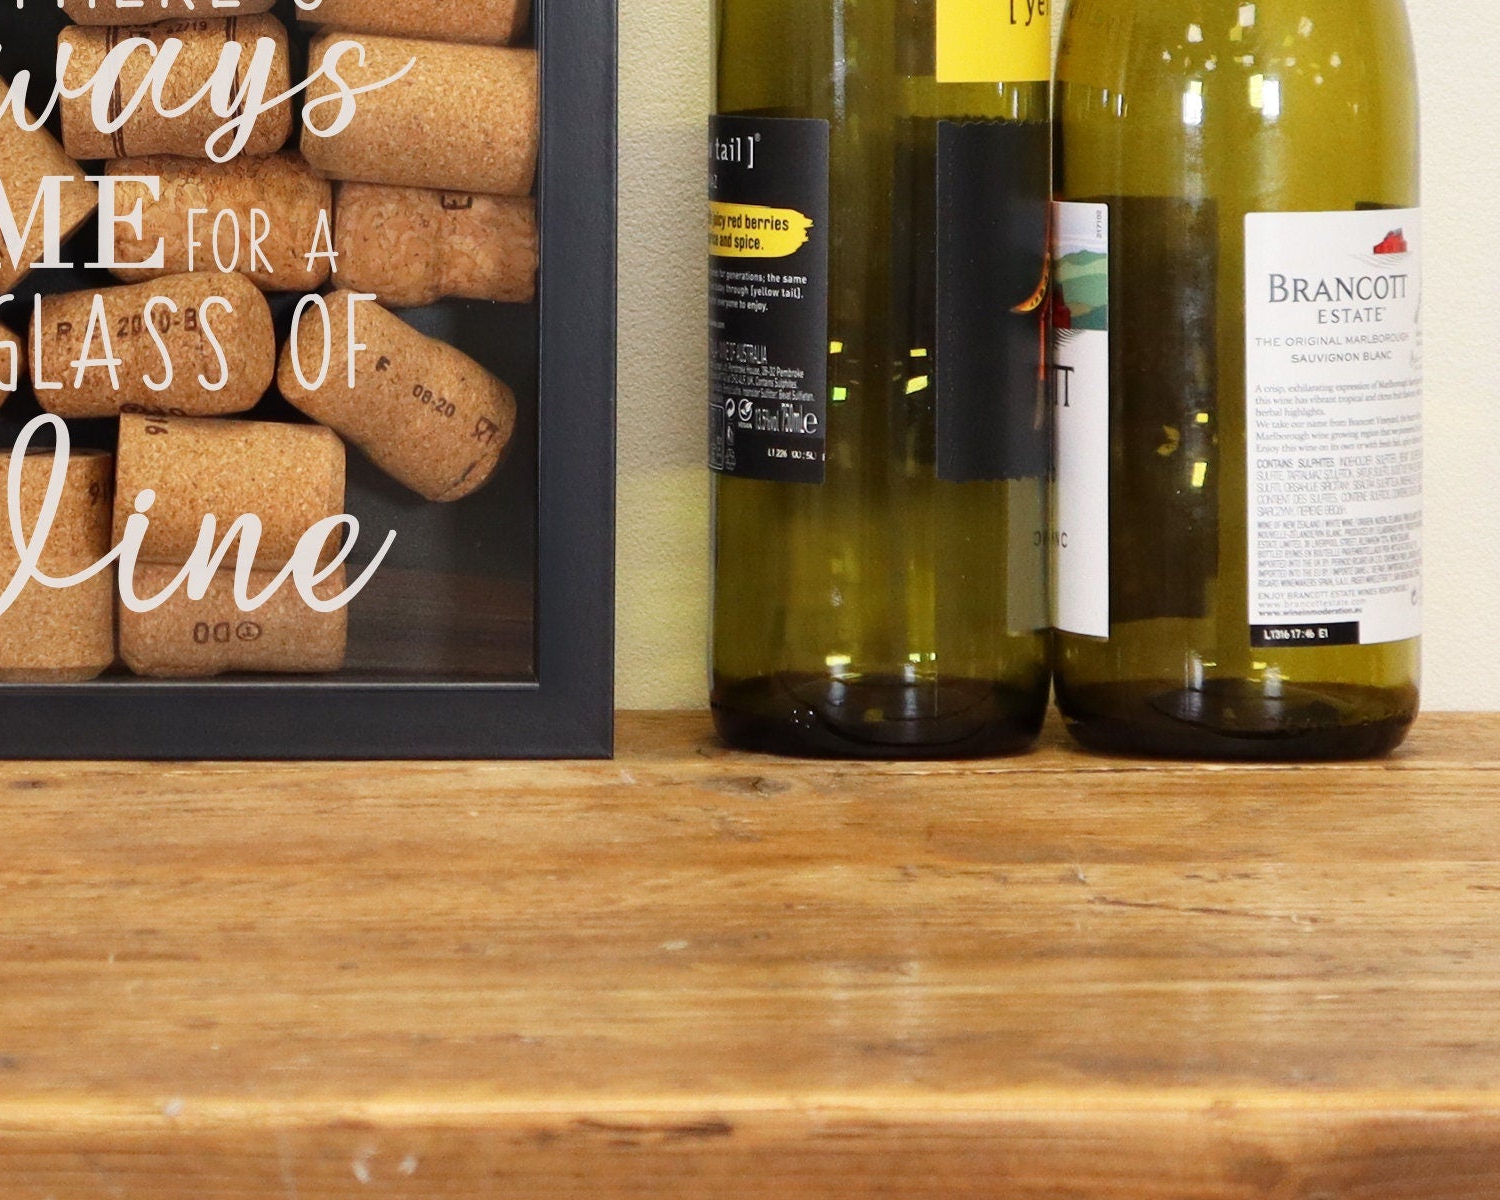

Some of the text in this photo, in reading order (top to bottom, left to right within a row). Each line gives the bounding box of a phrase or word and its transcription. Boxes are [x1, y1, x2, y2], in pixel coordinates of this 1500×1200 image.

[715, 137, 741, 162] tail
[727, 214, 742, 228] red
[745, 214, 789, 231] berries
[188, 208, 274, 273] FOR
[304, 208, 339, 272] A
[734, 234, 764, 252] spice.
[767, 273, 780, 282] the
[783, 276, 807, 284] same
[1268, 274, 1408, 303] BRANCOTT
[747, 300, 768, 312] enjoy.
[1318, 307, 1383, 324] ESTATE
[290, 293, 377, 391] OF
[1255, 337, 1281, 347] THE
[1285, 335, 1342, 347] ORIGINAL
[1291, 350, 1392, 364] SAUVIGNON BLANC
[1264, 385, 1285, 394] crisp,
[1288, 384, 1334, 393] exhilarating
[1255, 397, 1271, 405] this
[1309, 396, 1336, 404] vibrant
[1255, 408, 1326, 417] herbal highlights.
[1256, 420, 1270, 428] We
[1272, 420, 1289, 428] take
[1256, 432, 1310, 441] Marlborough
[1331, 431, 1359, 441] growing
[1256, 445, 1280, 454] Enjoy
[1282, 444, 1297, 452] this
[1256, 460, 1293, 469] CONTAINS
[1298, 457, 1335, 468] SULPHITES
[1287, 591, 1328, 599] BRANCOTT
[1331, 590, 1356, 598] ESTATE
